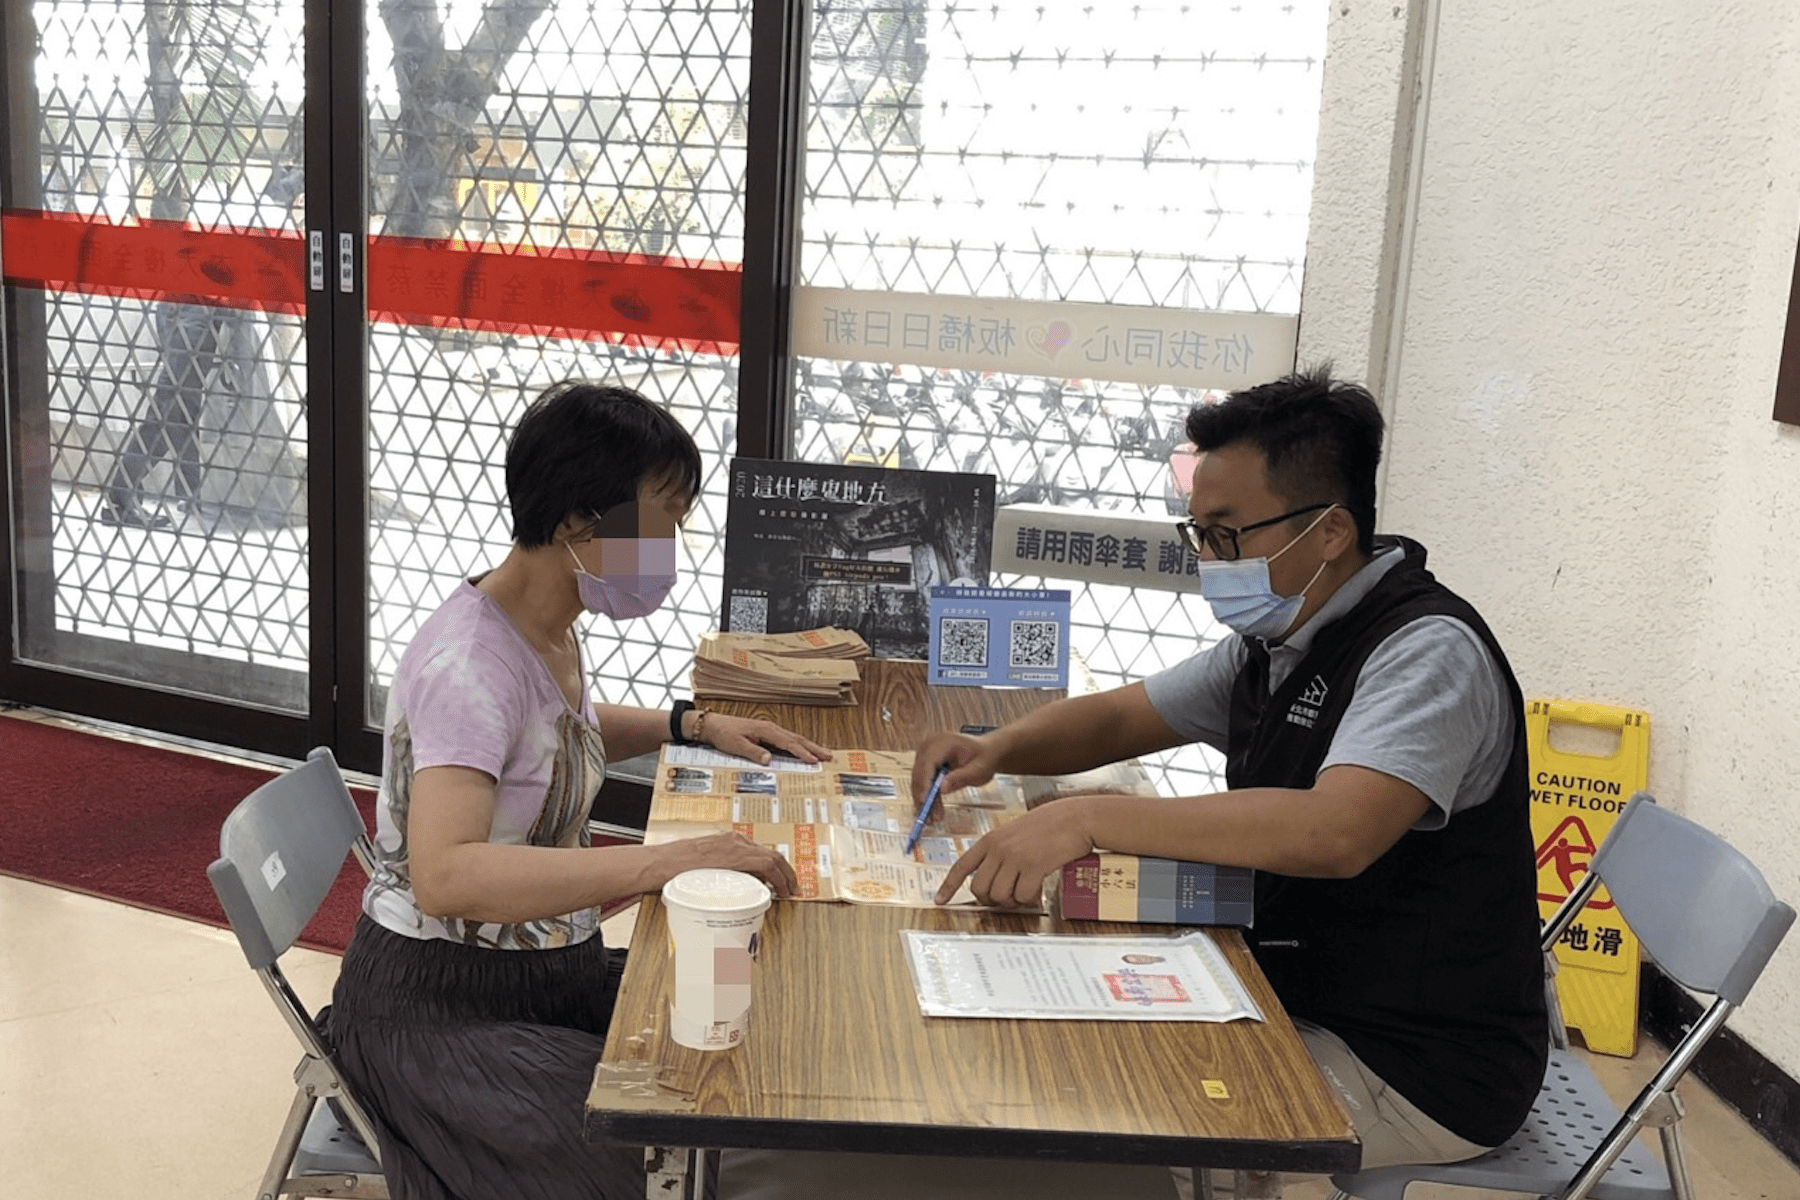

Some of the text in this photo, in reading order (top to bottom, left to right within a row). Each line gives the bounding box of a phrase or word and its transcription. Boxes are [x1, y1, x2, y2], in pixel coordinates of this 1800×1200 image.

[1016, 526, 1148, 572] 請用雨傘套
[1529, 789, 1564, 805] WET
[1537, 772, 1621, 795] CAUTION
[1540, 918, 1623, 957] 地滑
